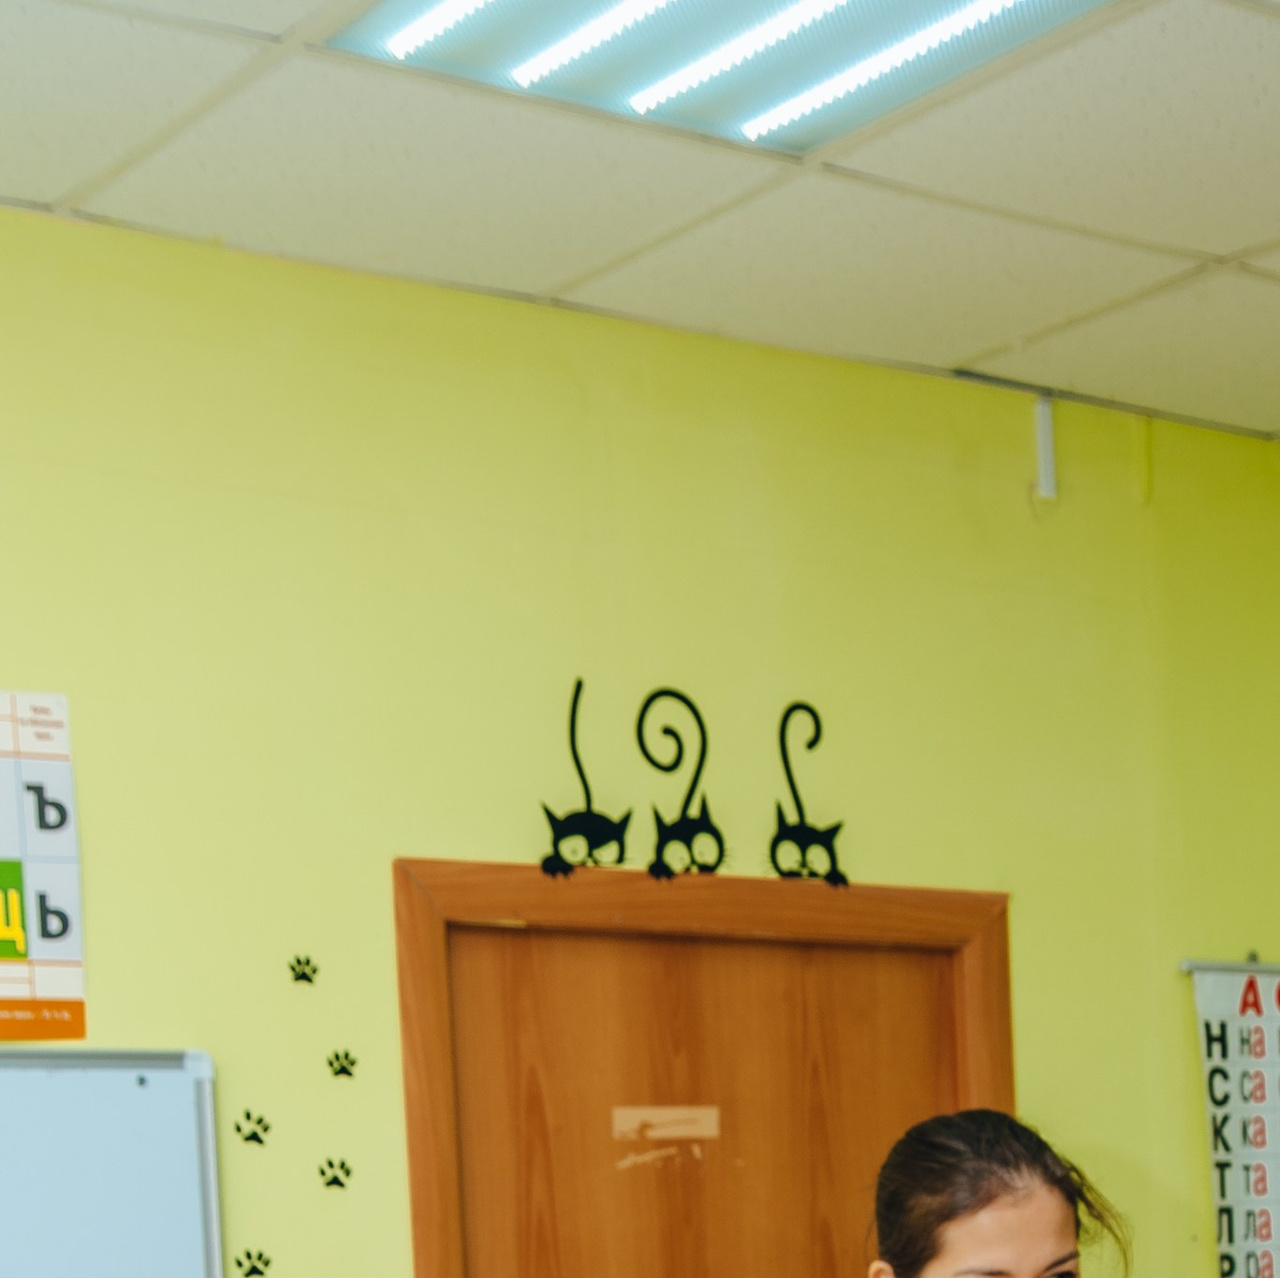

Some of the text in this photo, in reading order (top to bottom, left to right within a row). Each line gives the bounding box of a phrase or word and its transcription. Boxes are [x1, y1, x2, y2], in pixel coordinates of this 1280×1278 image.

[25, 784, 68, 830] Ъ
[38, 893, 70, 939] Ь
[1239, 975, 1263, 1016] А
[1205, 1020, 1228, 1059] Н
[1238, 1025, 1266, 1059] на
[1208, 1068, 1230, 1106] С
[1240, 1069, 1266, 1103] са
[1212, 1114, 1232, 1152] К
[1242, 1115, 1267, 1149] ка
[1215, 1162, 1232, 1199] Т
[1243, 1163, 1268, 1196] та
[1218, 1207, 1234, 1244] Л
[1245, 1208, 1272, 1242] ла
